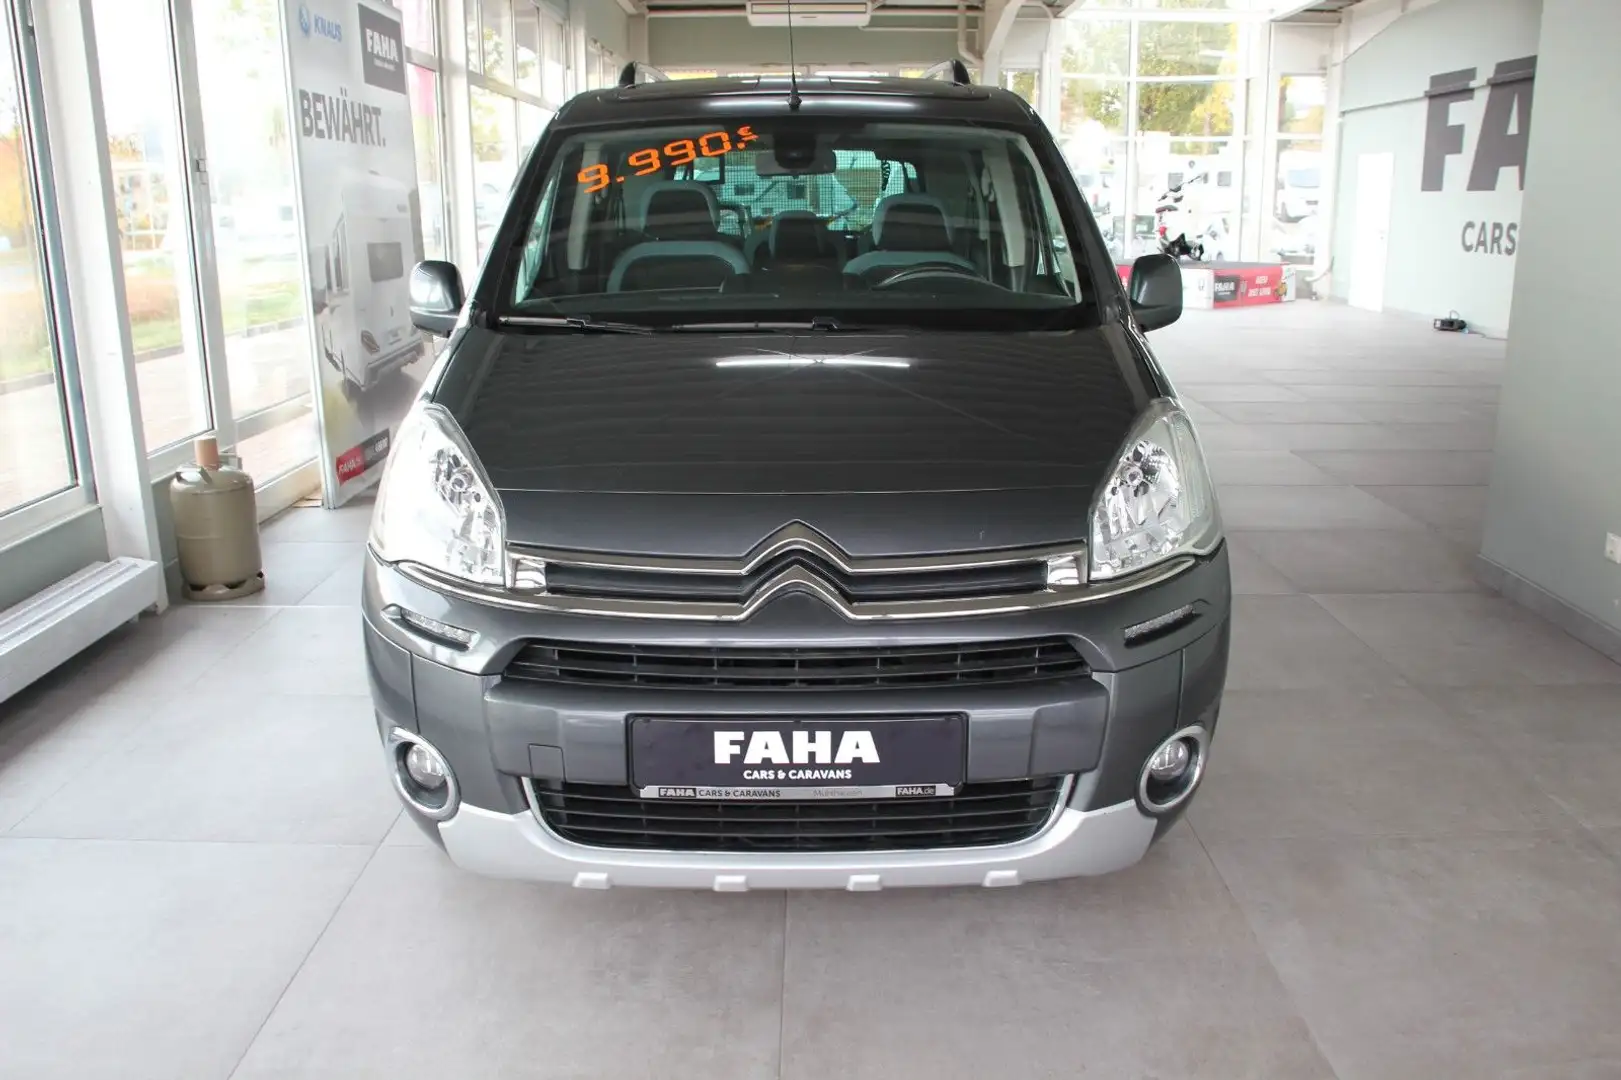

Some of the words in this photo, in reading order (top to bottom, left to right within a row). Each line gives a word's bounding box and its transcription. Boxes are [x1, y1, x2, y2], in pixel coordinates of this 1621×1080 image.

[314, 14, 342, 42] KNAUS
[365, 28, 399, 62] FAHA
[299, 86, 386, 147] BEWÄHRT.
[1461, 221, 1518, 256] CARS
[713, 731, 880, 764] FAHA
[743, 769, 775, 780] CARS
[777, 770, 786, 780] &
[788, 769, 852, 780] CARAVANS
[659, 788, 695, 798] FAHA
[699, 790, 723, 798] CARS
[724, 790, 731, 798] &
[733, 790, 781, 798] CARAVANS
[897, 786, 935, 796] FAHA.de
